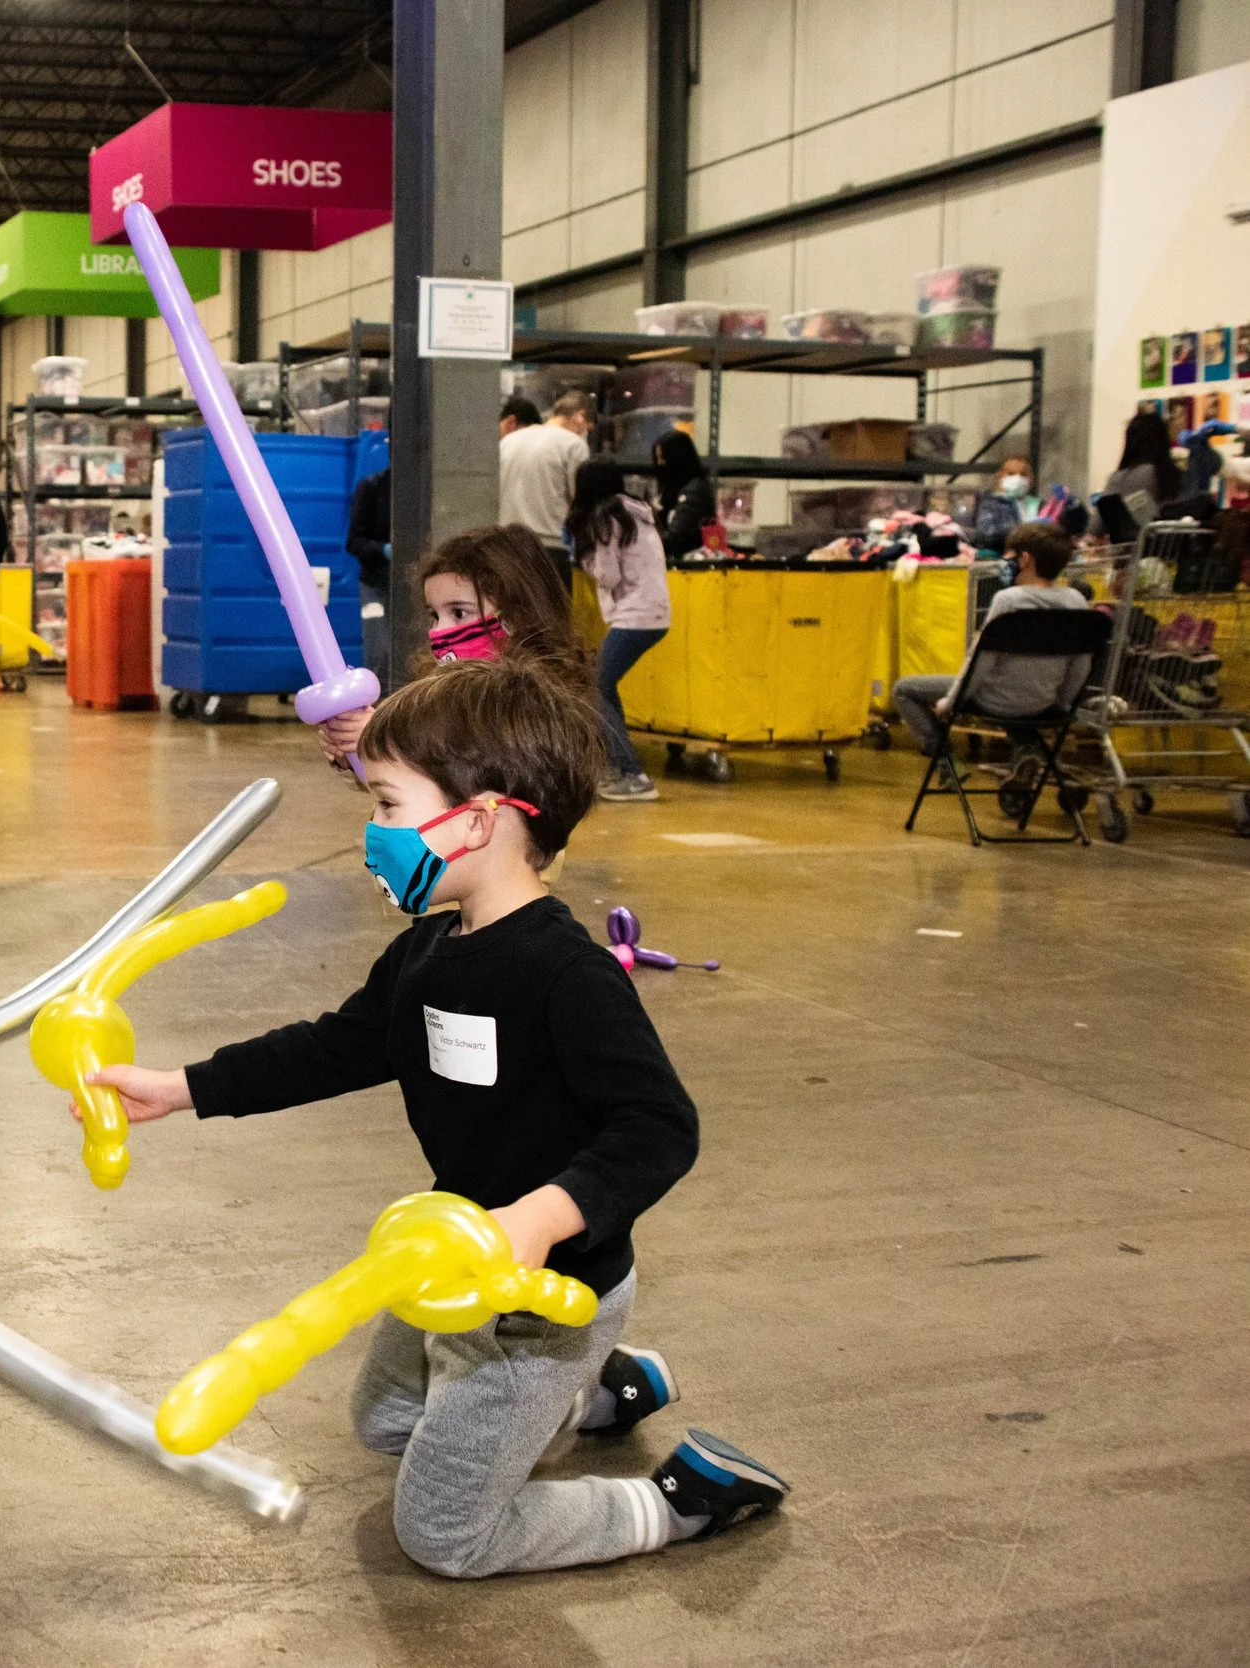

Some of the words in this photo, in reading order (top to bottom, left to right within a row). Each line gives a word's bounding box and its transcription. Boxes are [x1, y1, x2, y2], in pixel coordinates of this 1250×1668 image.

[252, 158, 342, 188] SHOES
[80, 252, 144, 275] LIBRA
[454, 1038, 486, 1050] Schwartz
